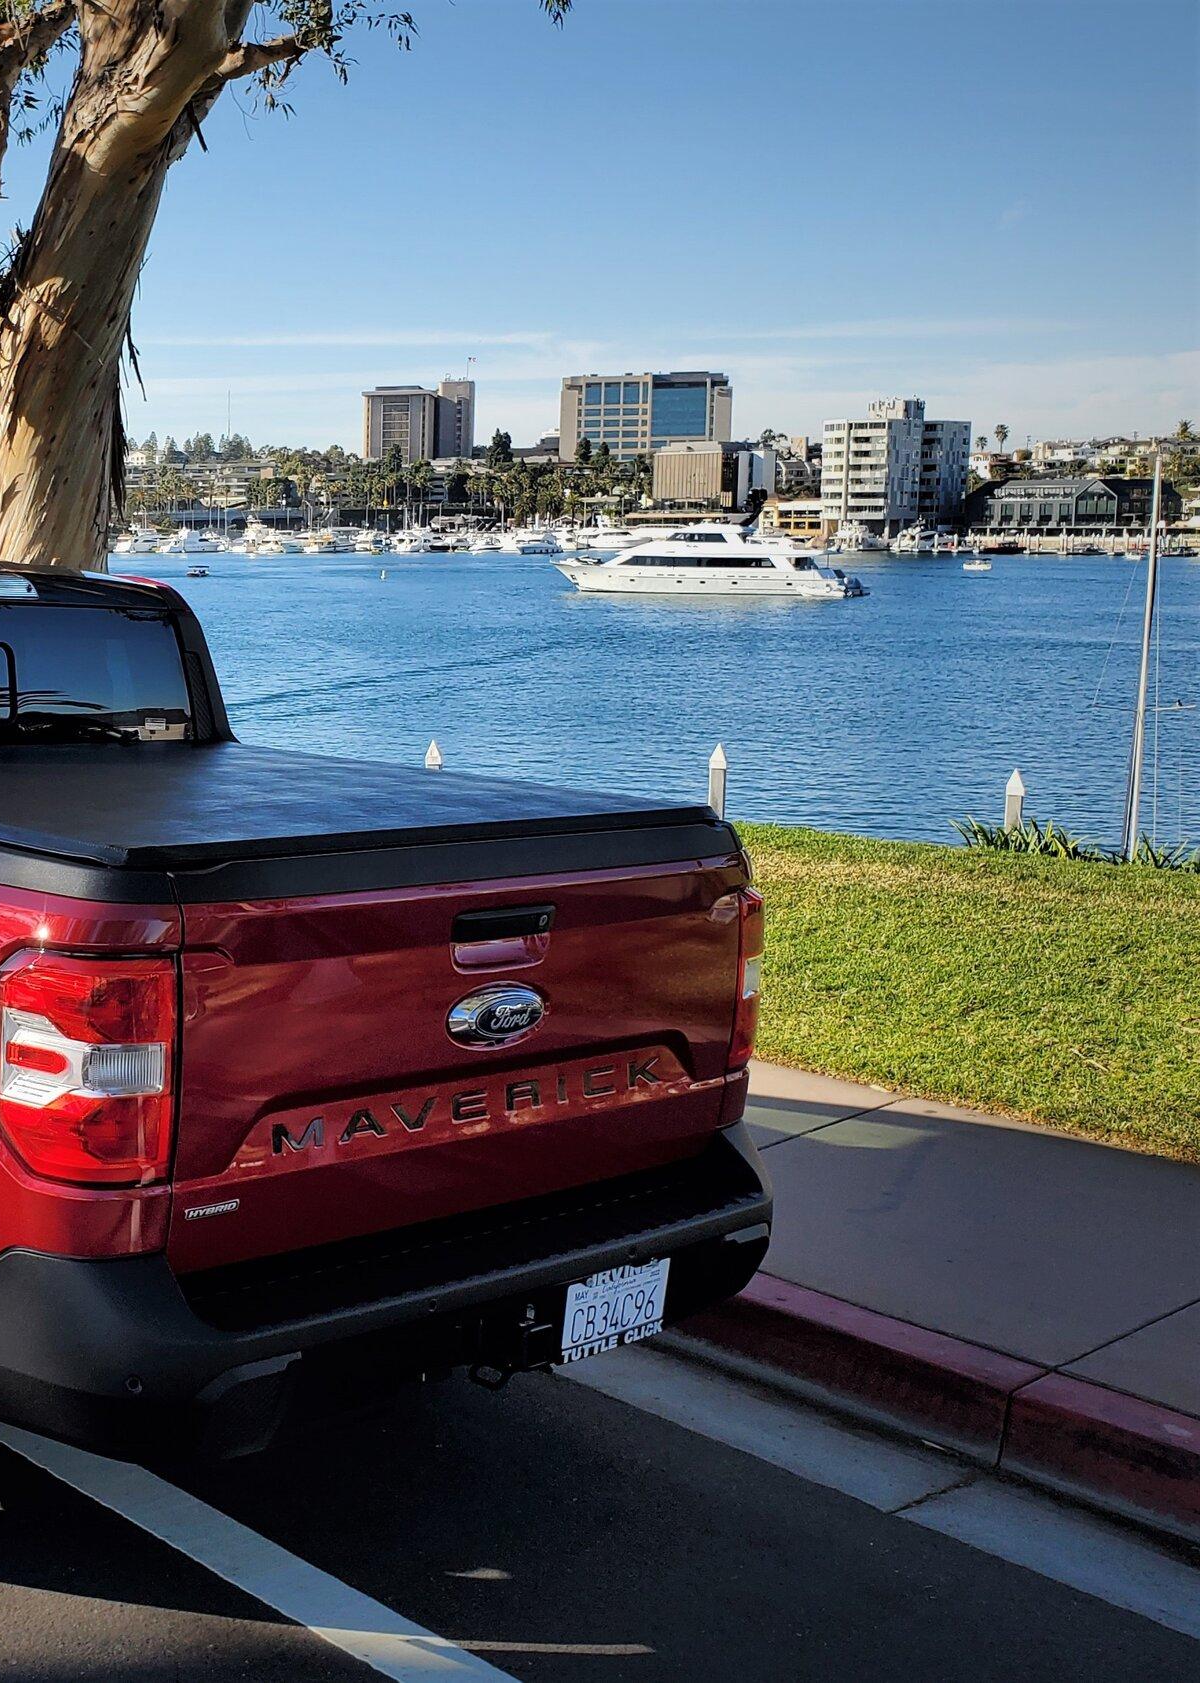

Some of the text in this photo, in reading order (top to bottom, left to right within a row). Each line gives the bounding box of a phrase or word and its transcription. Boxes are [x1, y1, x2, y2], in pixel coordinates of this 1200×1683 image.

[490, 1003, 531, 1030] Ford
[272, 1056, 661, 1157] MAVERICK
[188, 1202, 237, 1218] HYBRID
[575, 1290, 589, 1301] MAY
[570, 1284, 658, 1344] CB34C96
[561, 1319, 664, 1364] TUTTLE CLICK
